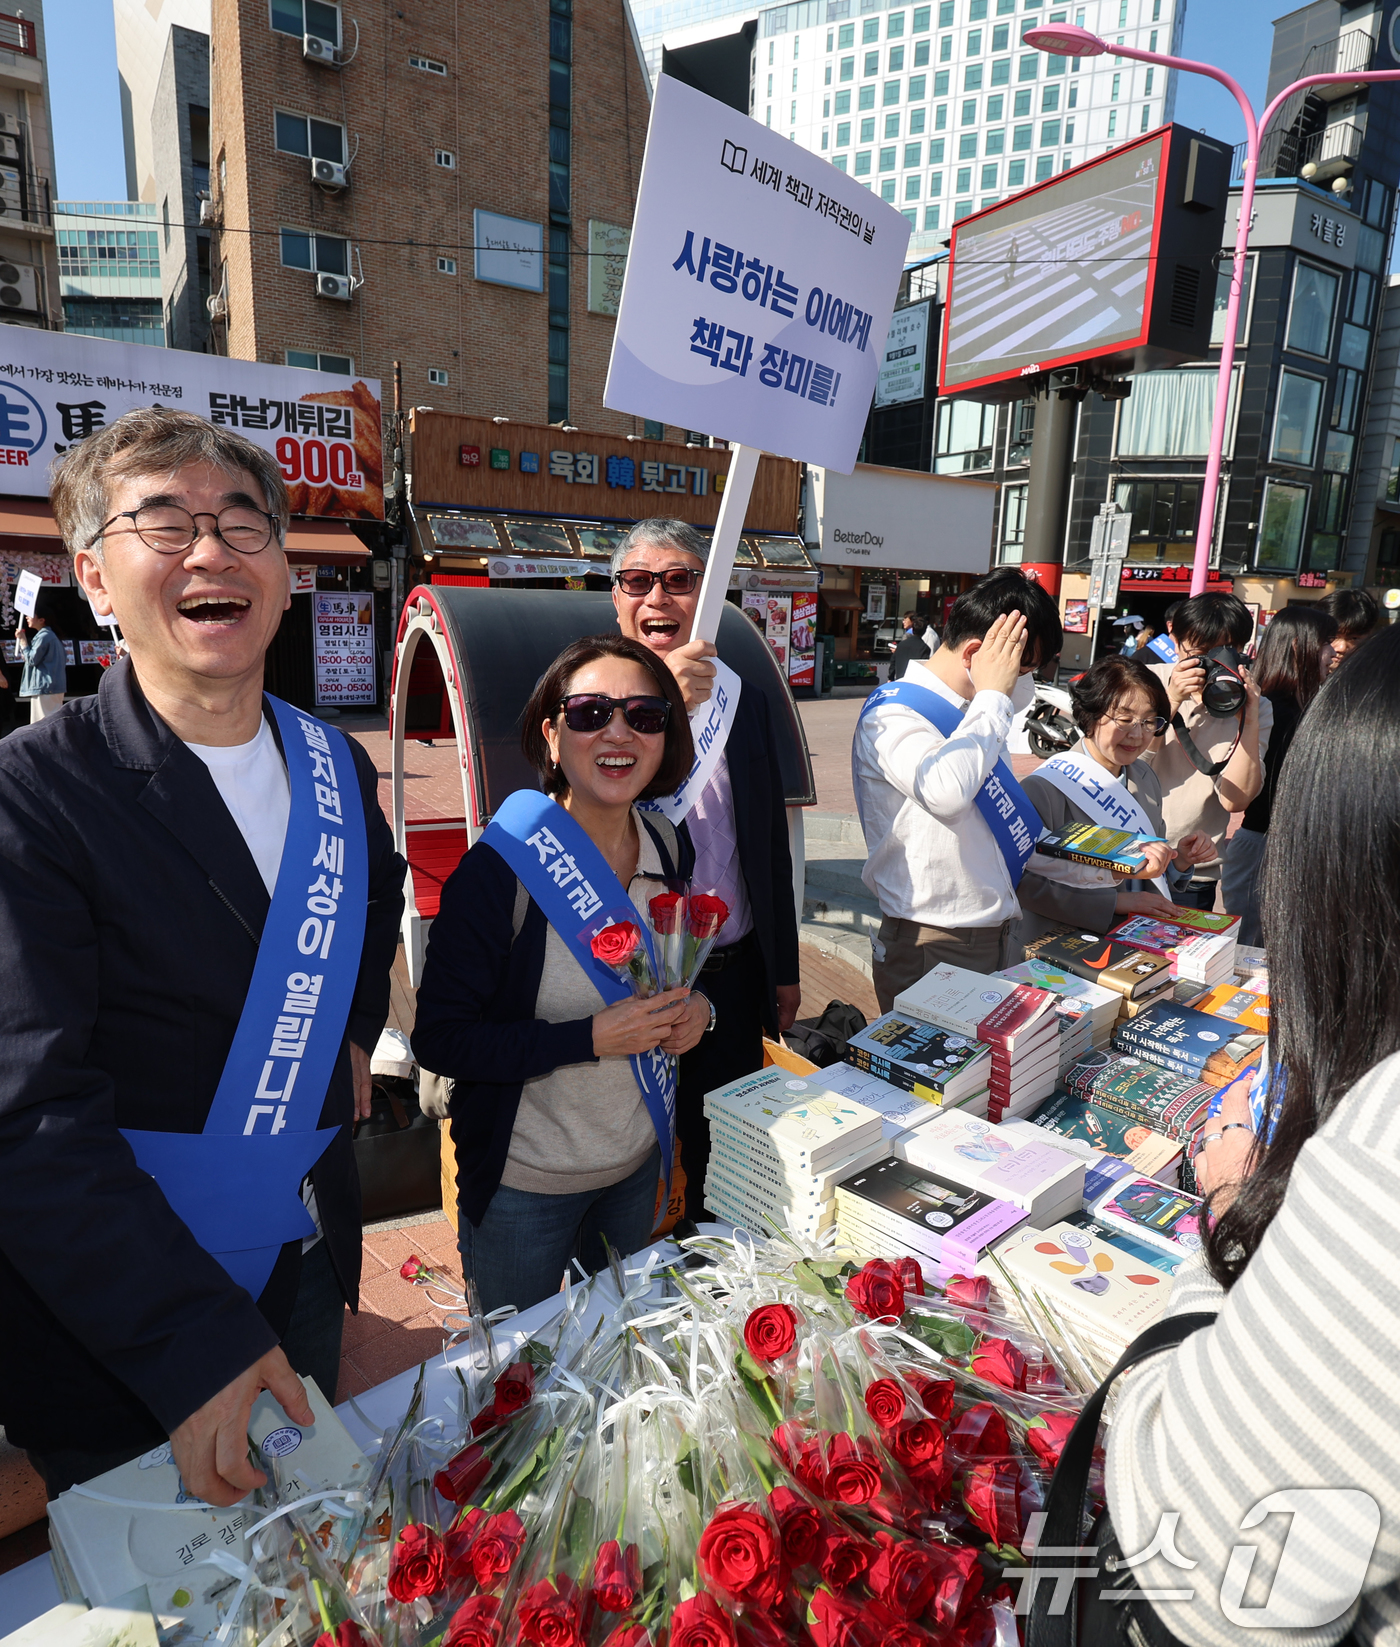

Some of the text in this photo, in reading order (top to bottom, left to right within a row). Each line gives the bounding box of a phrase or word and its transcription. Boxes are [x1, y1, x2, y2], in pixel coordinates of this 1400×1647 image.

[750, 157, 876, 246] 세계 책과 저작권의 날
[1311, 212, 1346, 248] 커플링
[672, 229, 872, 352] 사랑하는 이에게
[689, 316, 841, 407] 책과 장미를!
[27, 367, 54, 383] 가장
[57, 371, 94, 387] 맛있는
[96, 376, 147, 394] 테바나카
[149, 383, 183, 398] 전문점
[209, 392, 352, 440] 닭날개튀김
[275, 436, 362, 488] 900원
[462, 452, 479, 464] 한우
[522, 462, 538, 471] 가격
[548, 450, 599, 485] 육회
[606, 455, 635, 490] 韓
[641, 460, 709, 496] 뒷고기
[833, 528, 884, 548] BetterDay
[318, 568, 335, 577] 145-1
[319, 601, 358, 615] 生 馬車
[319, 624, 369, 637] 영업시간
[317, 656, 372, 665] 15:00-05:00
[318, 684, 373, 692] 13:00-05:00
[698, 685, 729, 756] 더 나은
[1082, 778, 1138, 828] 나누고,
[525, 826, 603, 921] 저작권
[1071, 853, 1132, 874] SUPERMATH
[243, 716, 345, 1135] 펼치면 세상이 열립니다
[868, 1019, 912, 1045] 코인
[1133, 1019, 1157, 1032] 다시
[1150, 1017, 1186, 1038] 시작하는
[1165, 1030, 1190, 1044] 독서
[857, 1048, 870, 1060] 코인
[1117, 1041, 1184, 1073] 다시 시작하는 독서
[1122, 1031, 1189, 1061] 다시 시작하는 독서
[856, 1058, 870, 1070] 코인
[176, 1533, 212, 1565] 길로
